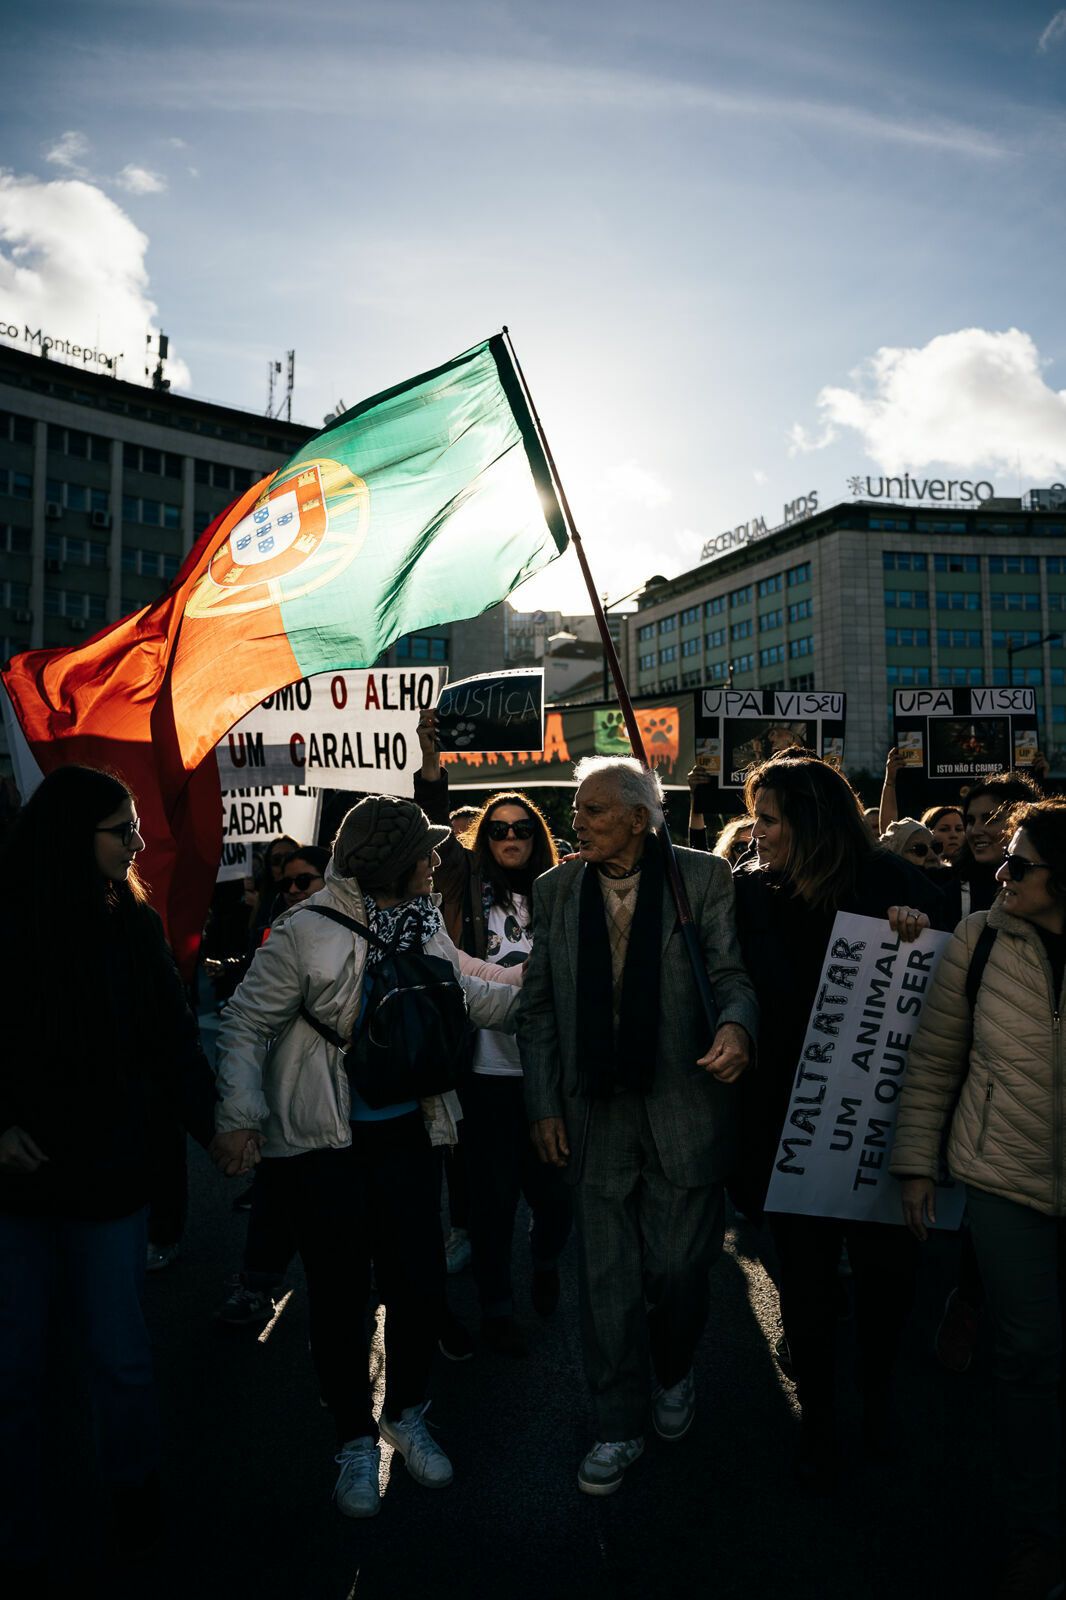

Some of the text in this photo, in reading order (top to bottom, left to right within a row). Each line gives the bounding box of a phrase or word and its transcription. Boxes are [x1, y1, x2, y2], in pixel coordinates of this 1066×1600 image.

[25, 325, 109, 365] Montepio
[866, 472, 994, 502] universo
[701, 490, 818, 561] ASCENDUM MDS
[331, 675, 348, 710] O
[365, 673, 434, 711] ALHO
[703, 691, 841, 716] UPA VISEU
[899, 689, 1034, 712] UPA VISEU
[228, 731, 407, 770] UM CARALHO
[936, 764, 953, 774] ISTO
[954, 762, 969, 773] NÃO
[730, 771, 746, 783] IST
[776, 937, 867, 1176] MALTRATAR
[829, 931, 901, 1152] UM ANIMAL
[853, 949, 936, 1192] TEM QUE SER
